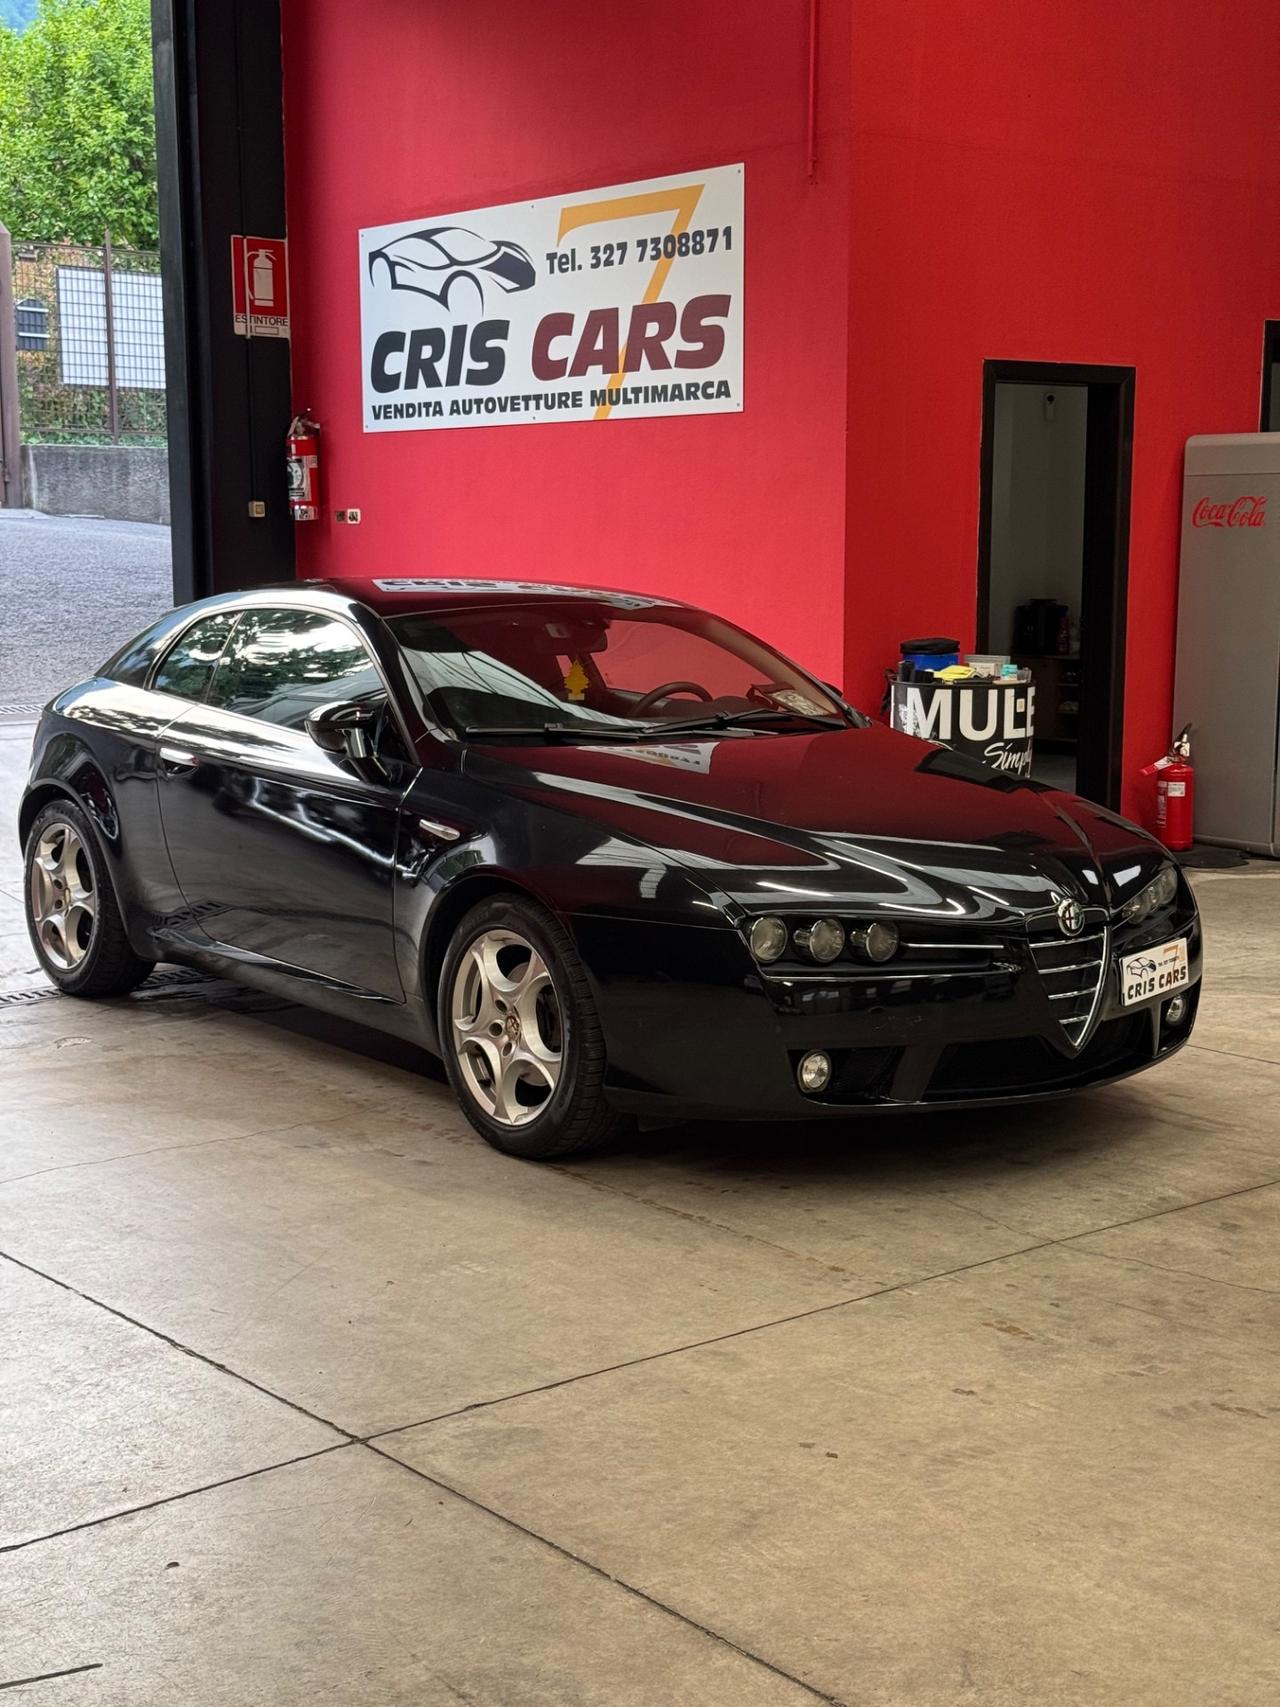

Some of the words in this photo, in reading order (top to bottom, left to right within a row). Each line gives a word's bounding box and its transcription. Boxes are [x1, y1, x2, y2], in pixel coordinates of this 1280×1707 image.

[546, 248, 583, 275] Tel.
[590, 241, 628, 269] 327
[636, 226, 732, 263] 7308871
[235, 315, 288, 326] ESTINTORE
[370, 319, 511, 394] CRIS
[531, 294, 732, 381] CARS
[372, 400, 444, 420] VENDITA
[449, 391, 583, 416] AUTOVETTURE
[590, 380, 731, 407] MULTIMARCA
[1127, 977, 1155, 1000] CRIS
[1158, 965, 1186, 989] CARS
